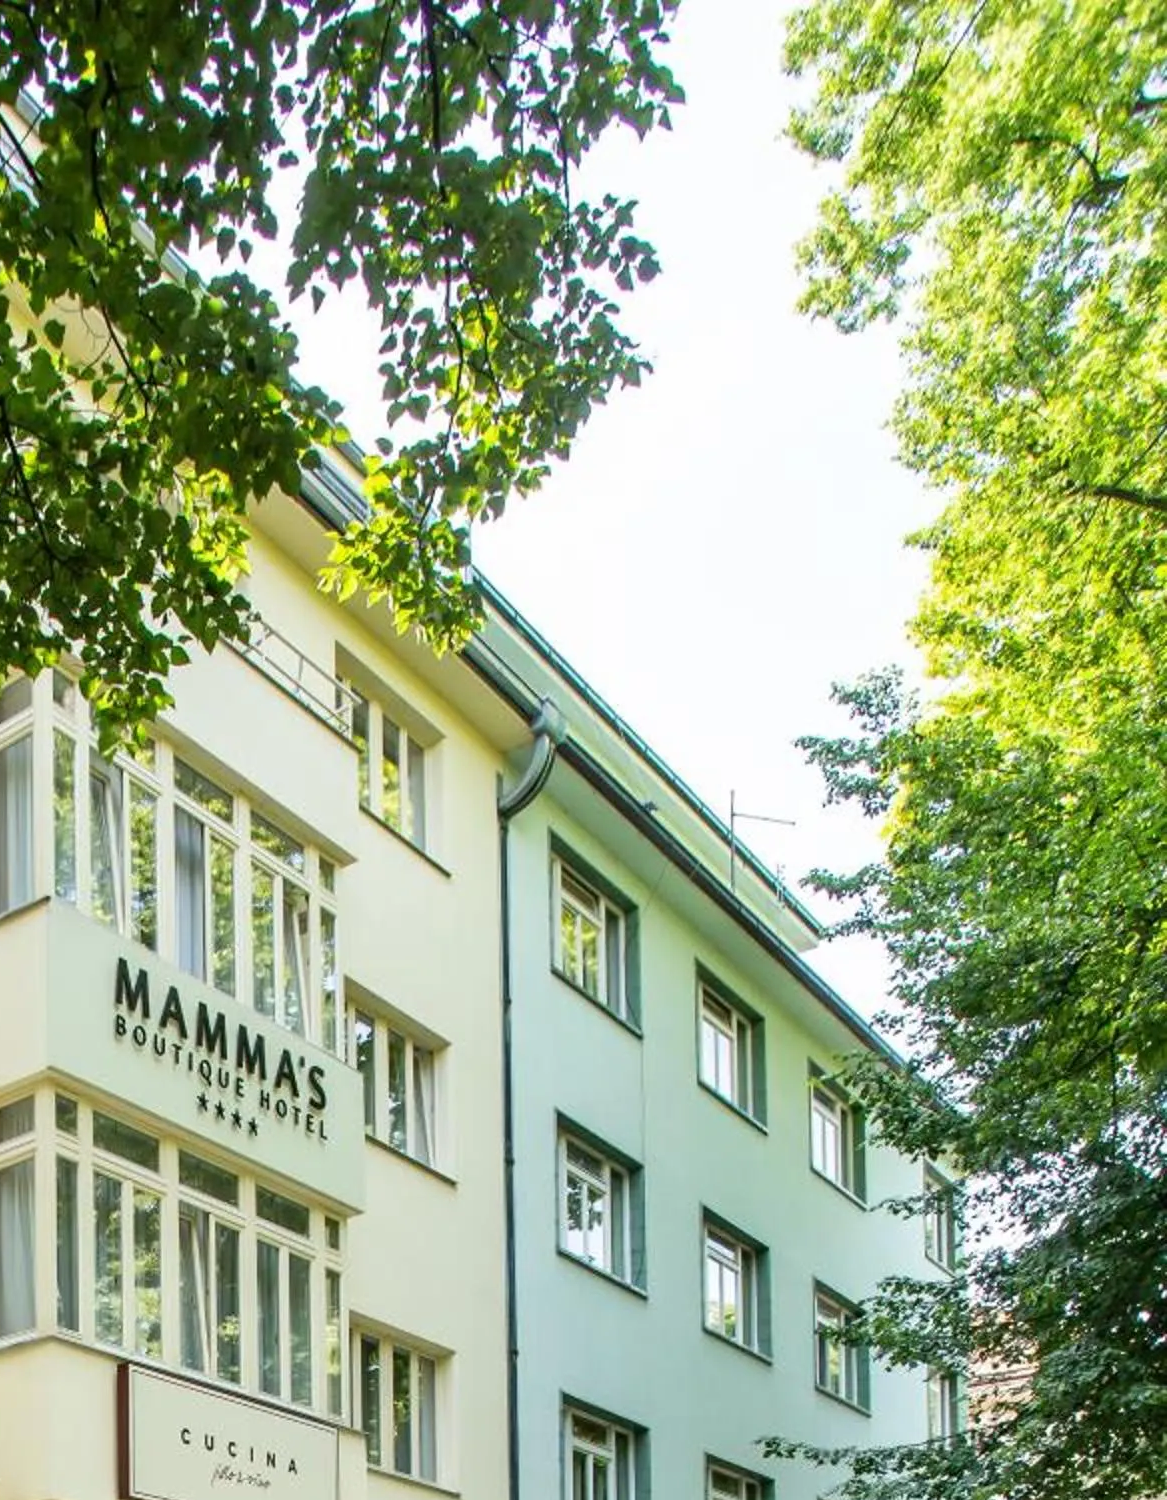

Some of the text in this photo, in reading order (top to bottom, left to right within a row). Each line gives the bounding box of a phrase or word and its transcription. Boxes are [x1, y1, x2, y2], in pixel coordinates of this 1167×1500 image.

[115, 957, 327, 1110] MAMMA'S
[115, 1014, 328, 1140] BOUTIQUE HOTEL
[180, 1428, 298, 1475] CUCINA
